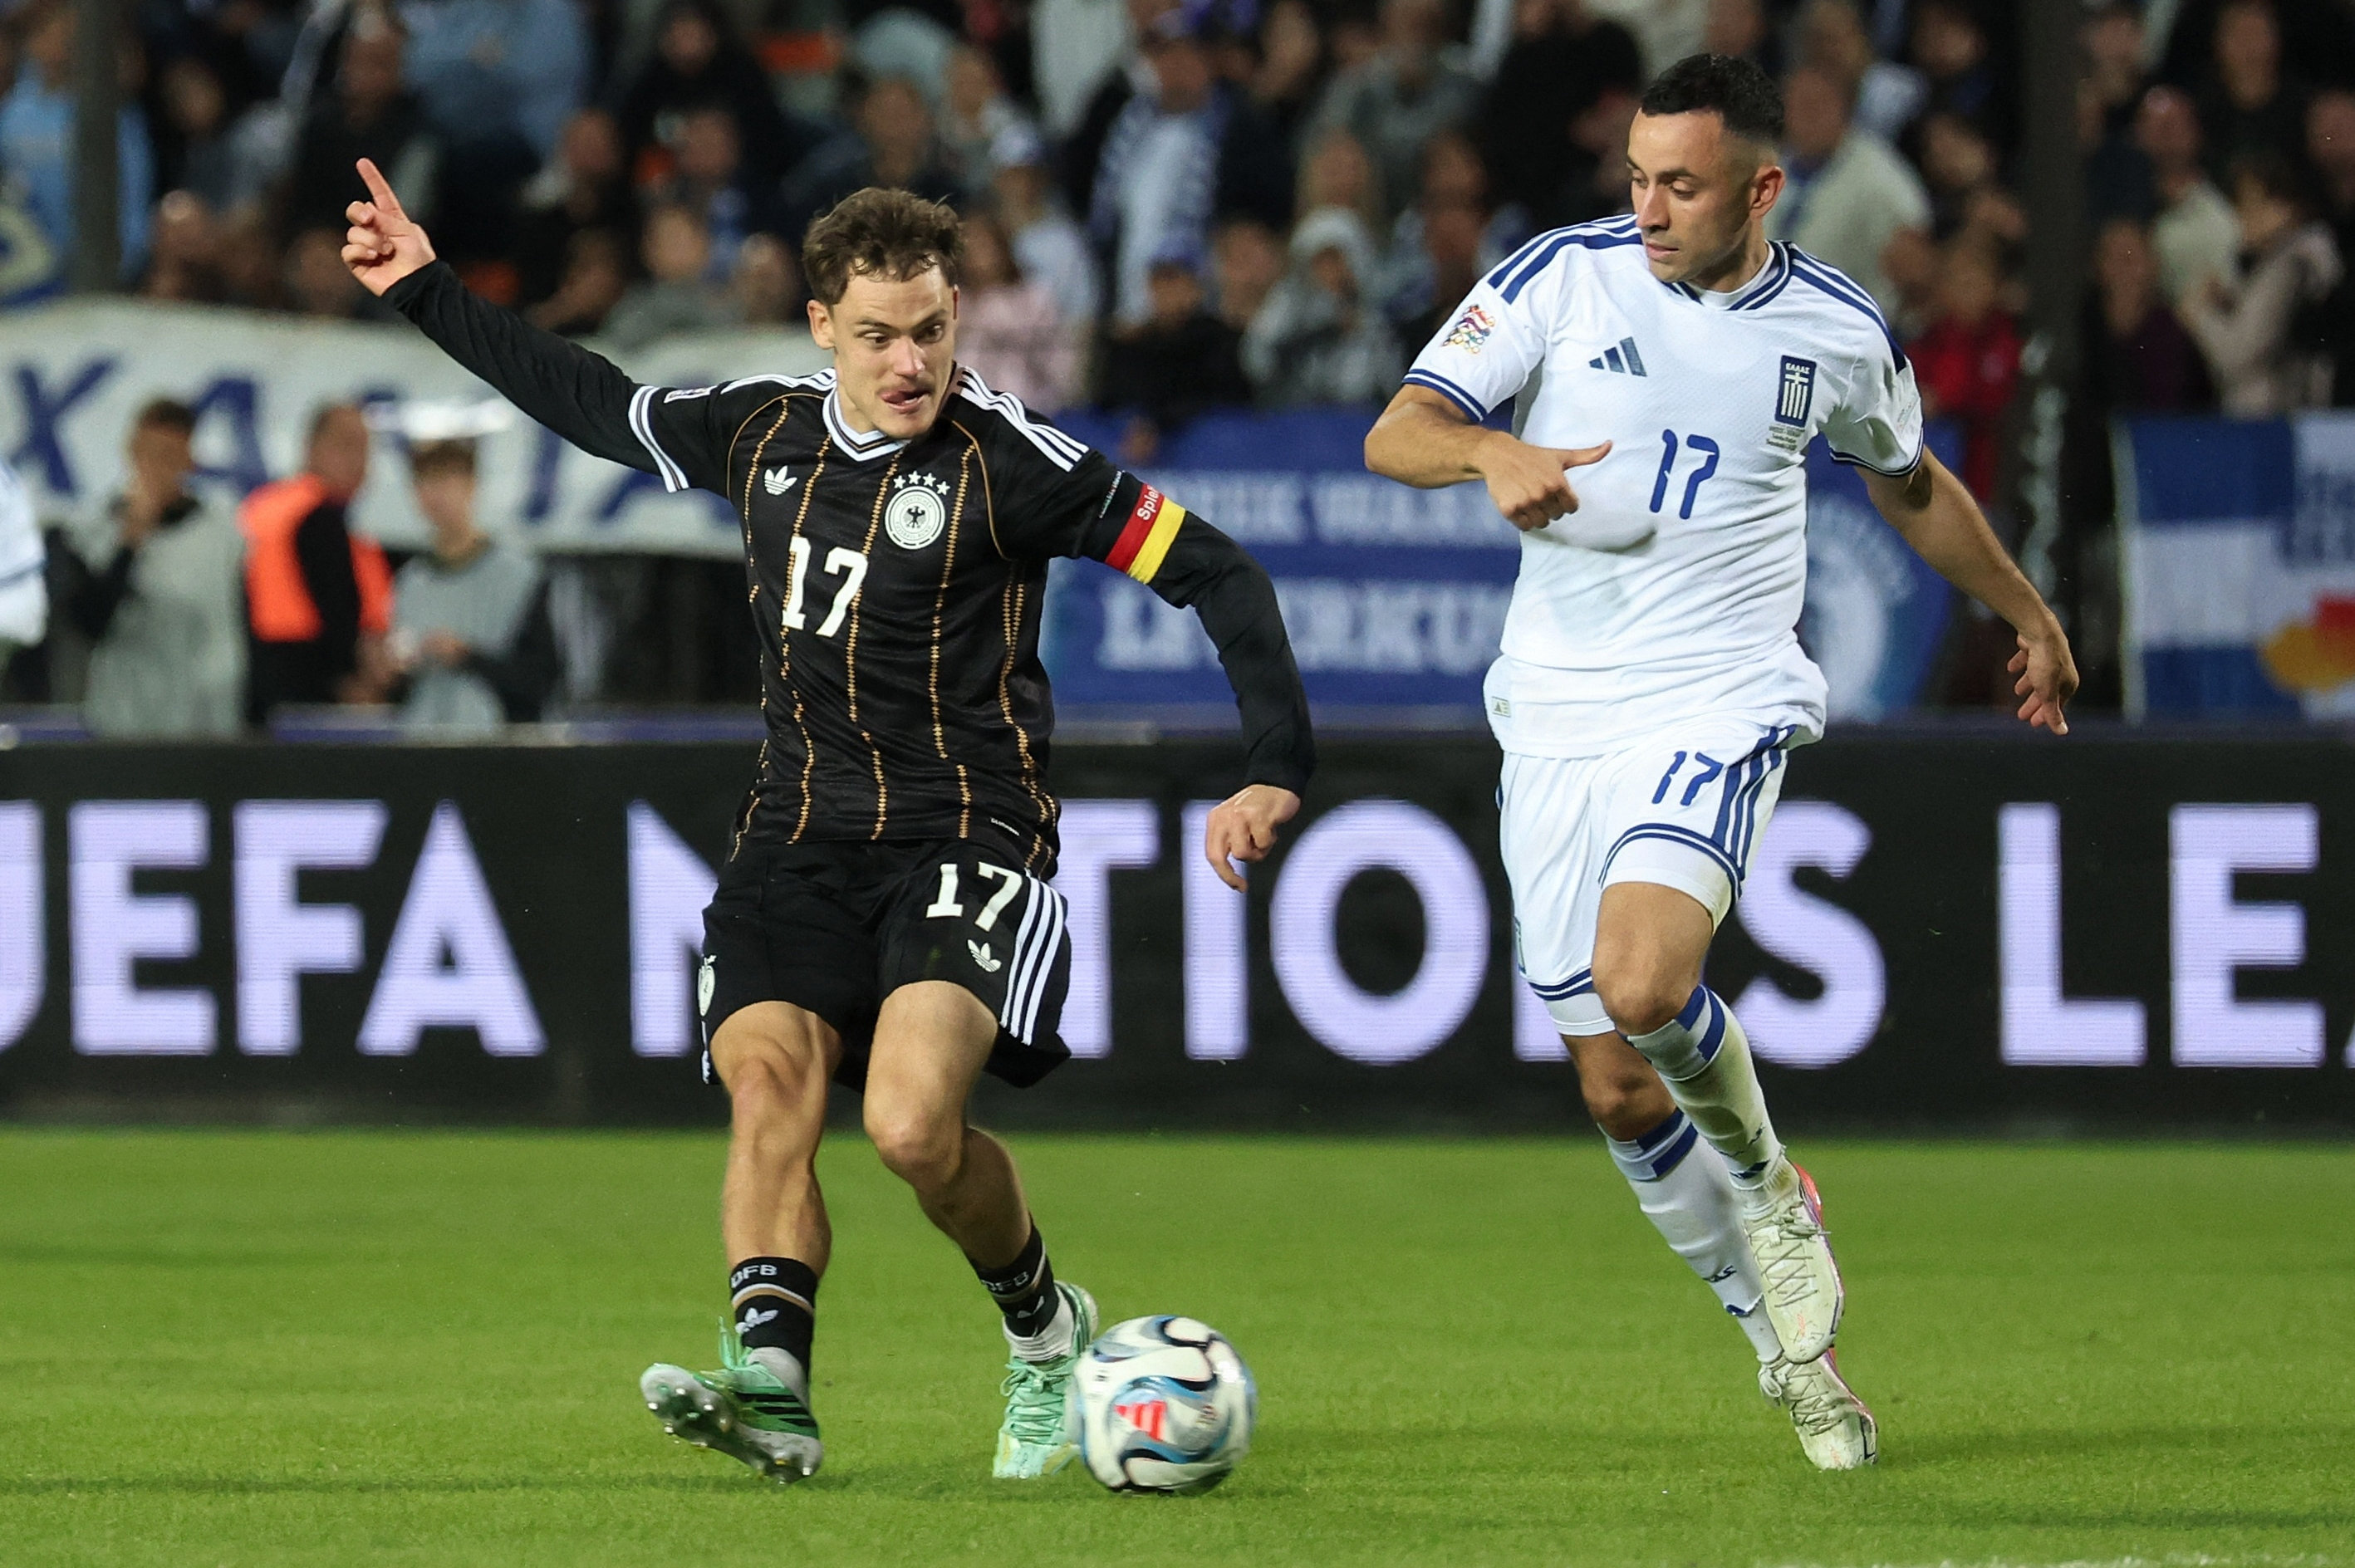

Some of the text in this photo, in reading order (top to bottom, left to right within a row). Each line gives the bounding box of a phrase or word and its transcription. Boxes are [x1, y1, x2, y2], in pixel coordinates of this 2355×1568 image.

[1649, 429, 1720, 521] 17
[781, 533, 872, 637] 17
[1651, 751, 1725, 806] 17
[627, 798, 1885, 1069] NTIOS
[1999, 802, 2355, 1067] LE
[925, 862, 1023, 933] 17
[730, 1264, 778, 1289] DFB
